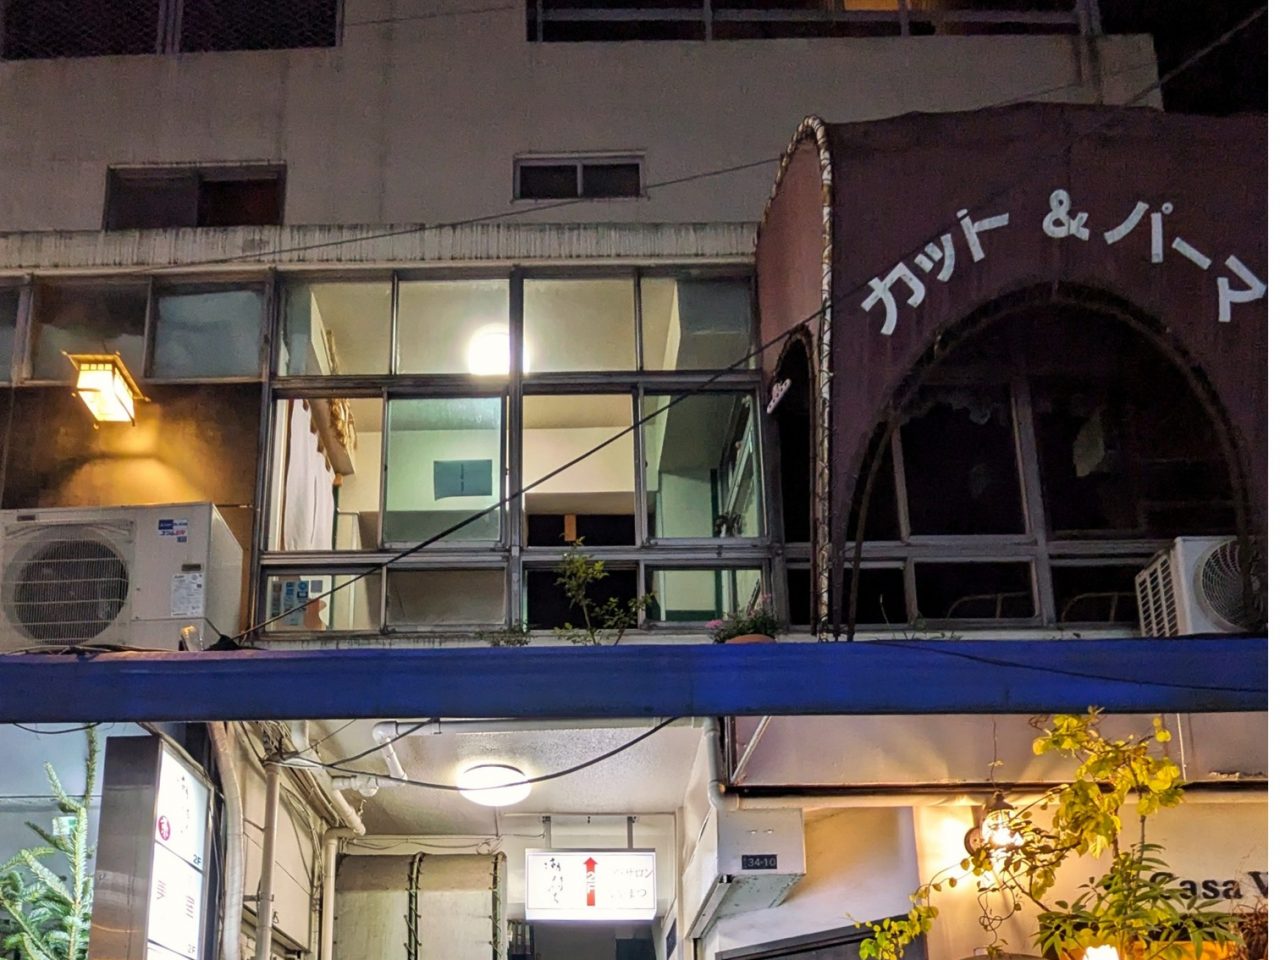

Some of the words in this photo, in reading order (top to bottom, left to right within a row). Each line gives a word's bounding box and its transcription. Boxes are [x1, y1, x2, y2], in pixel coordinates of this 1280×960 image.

[860, 208, 1009, 335] カット
[1042, 188, 1090, 241] &
[1103, 201, 1267, 323] パーマ
